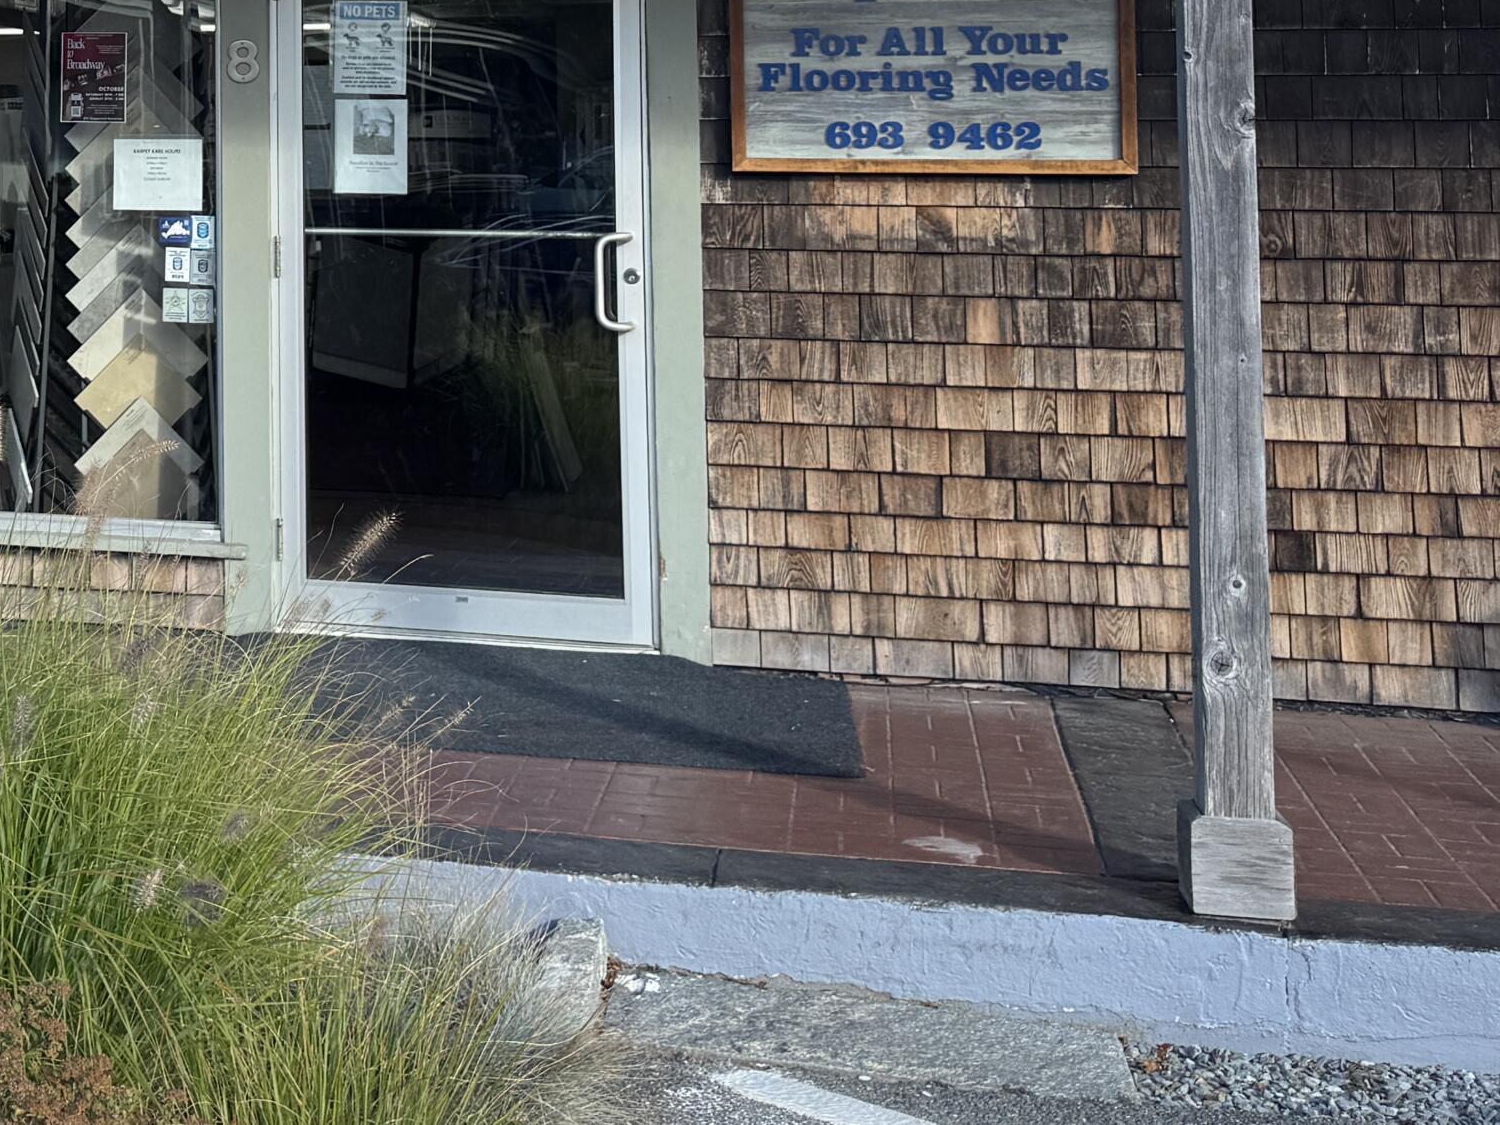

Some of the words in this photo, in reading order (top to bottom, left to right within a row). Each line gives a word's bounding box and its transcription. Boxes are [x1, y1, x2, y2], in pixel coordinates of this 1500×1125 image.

[343, 5, 361, 17] NO
[364, 5, 396, 18] PETS
[67, 38, 85, 49] Back
[791, 27, 867, 57] For
[877, 26, 947, 57] All
[958, 25, 1068, 55] Your
[67, 59, 105, 71] Broadway
[227, 39, 260, 83] 8
[757, 62, 954, 100] Flooring
[971, 61, 1109, 93] Needs
[825, 120, 904, 150] 693
[928, 121, 1042, 150] 9462
